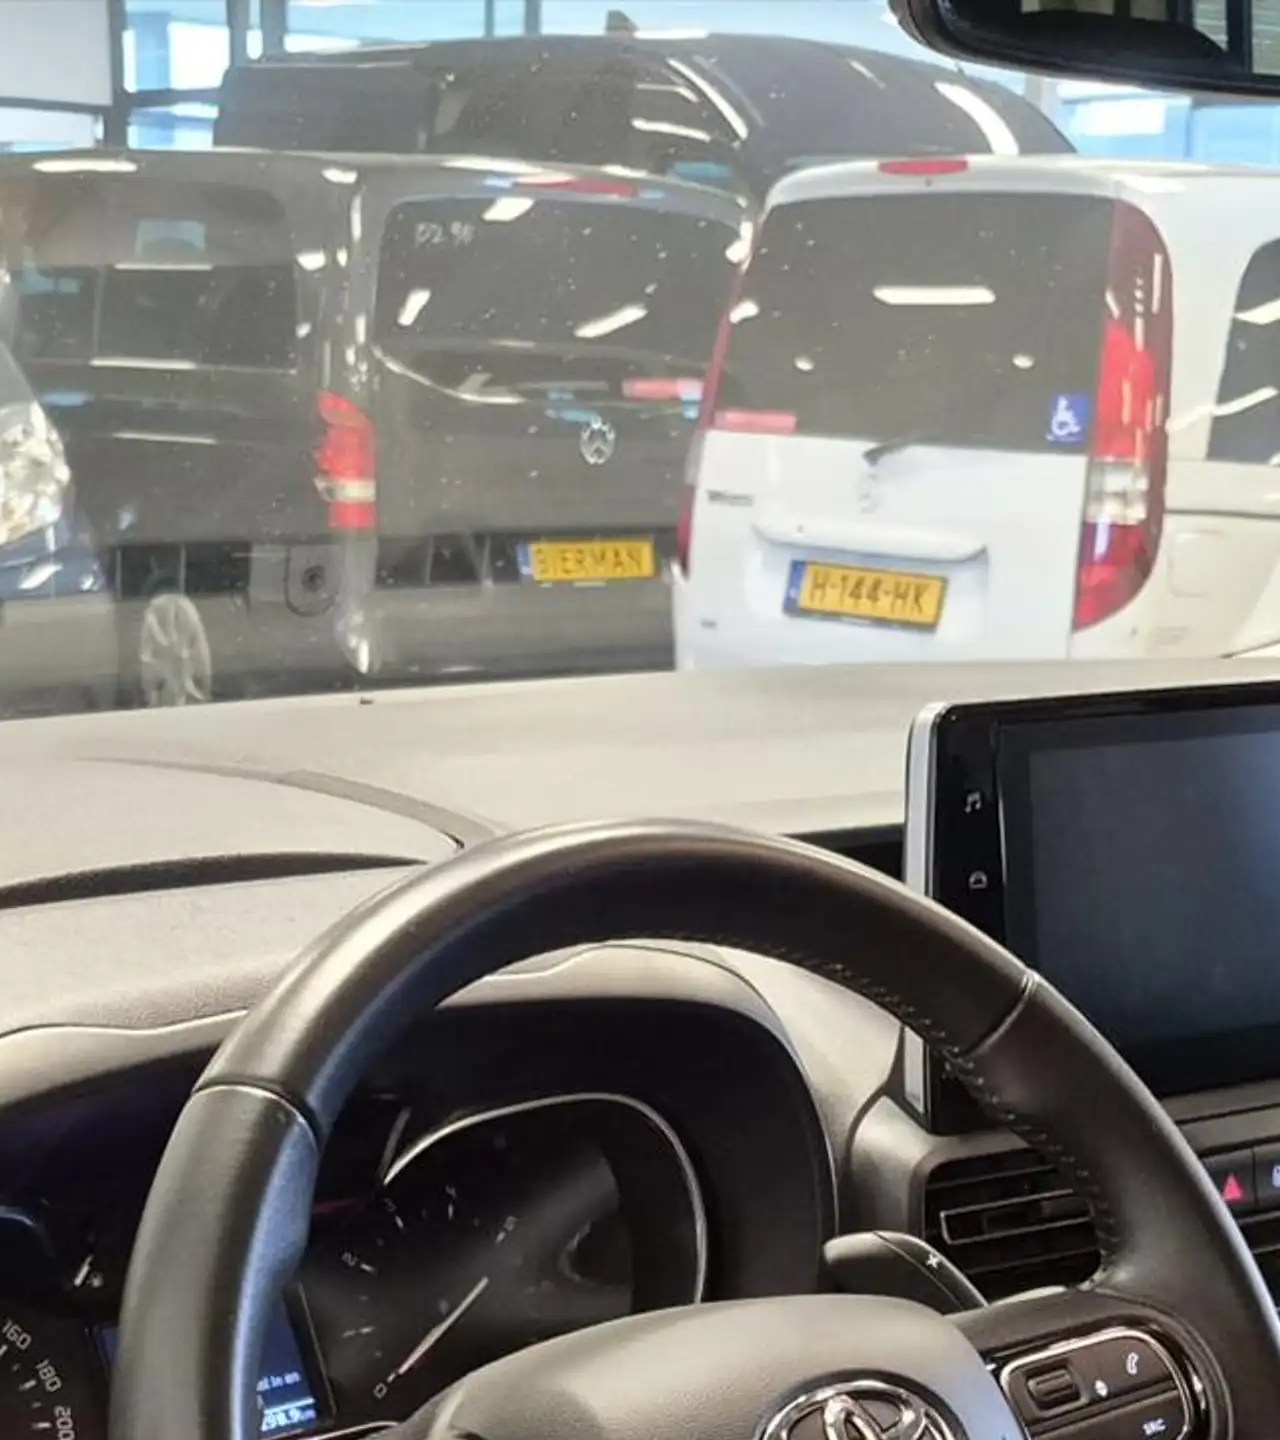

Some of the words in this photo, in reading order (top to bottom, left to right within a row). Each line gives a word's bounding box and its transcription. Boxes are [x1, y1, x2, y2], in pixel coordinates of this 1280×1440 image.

[808, 567, 930, 616] H-144-HK
[1, 1319, 32, 1351] 160
[35, 1357, 63, 1393] 180
